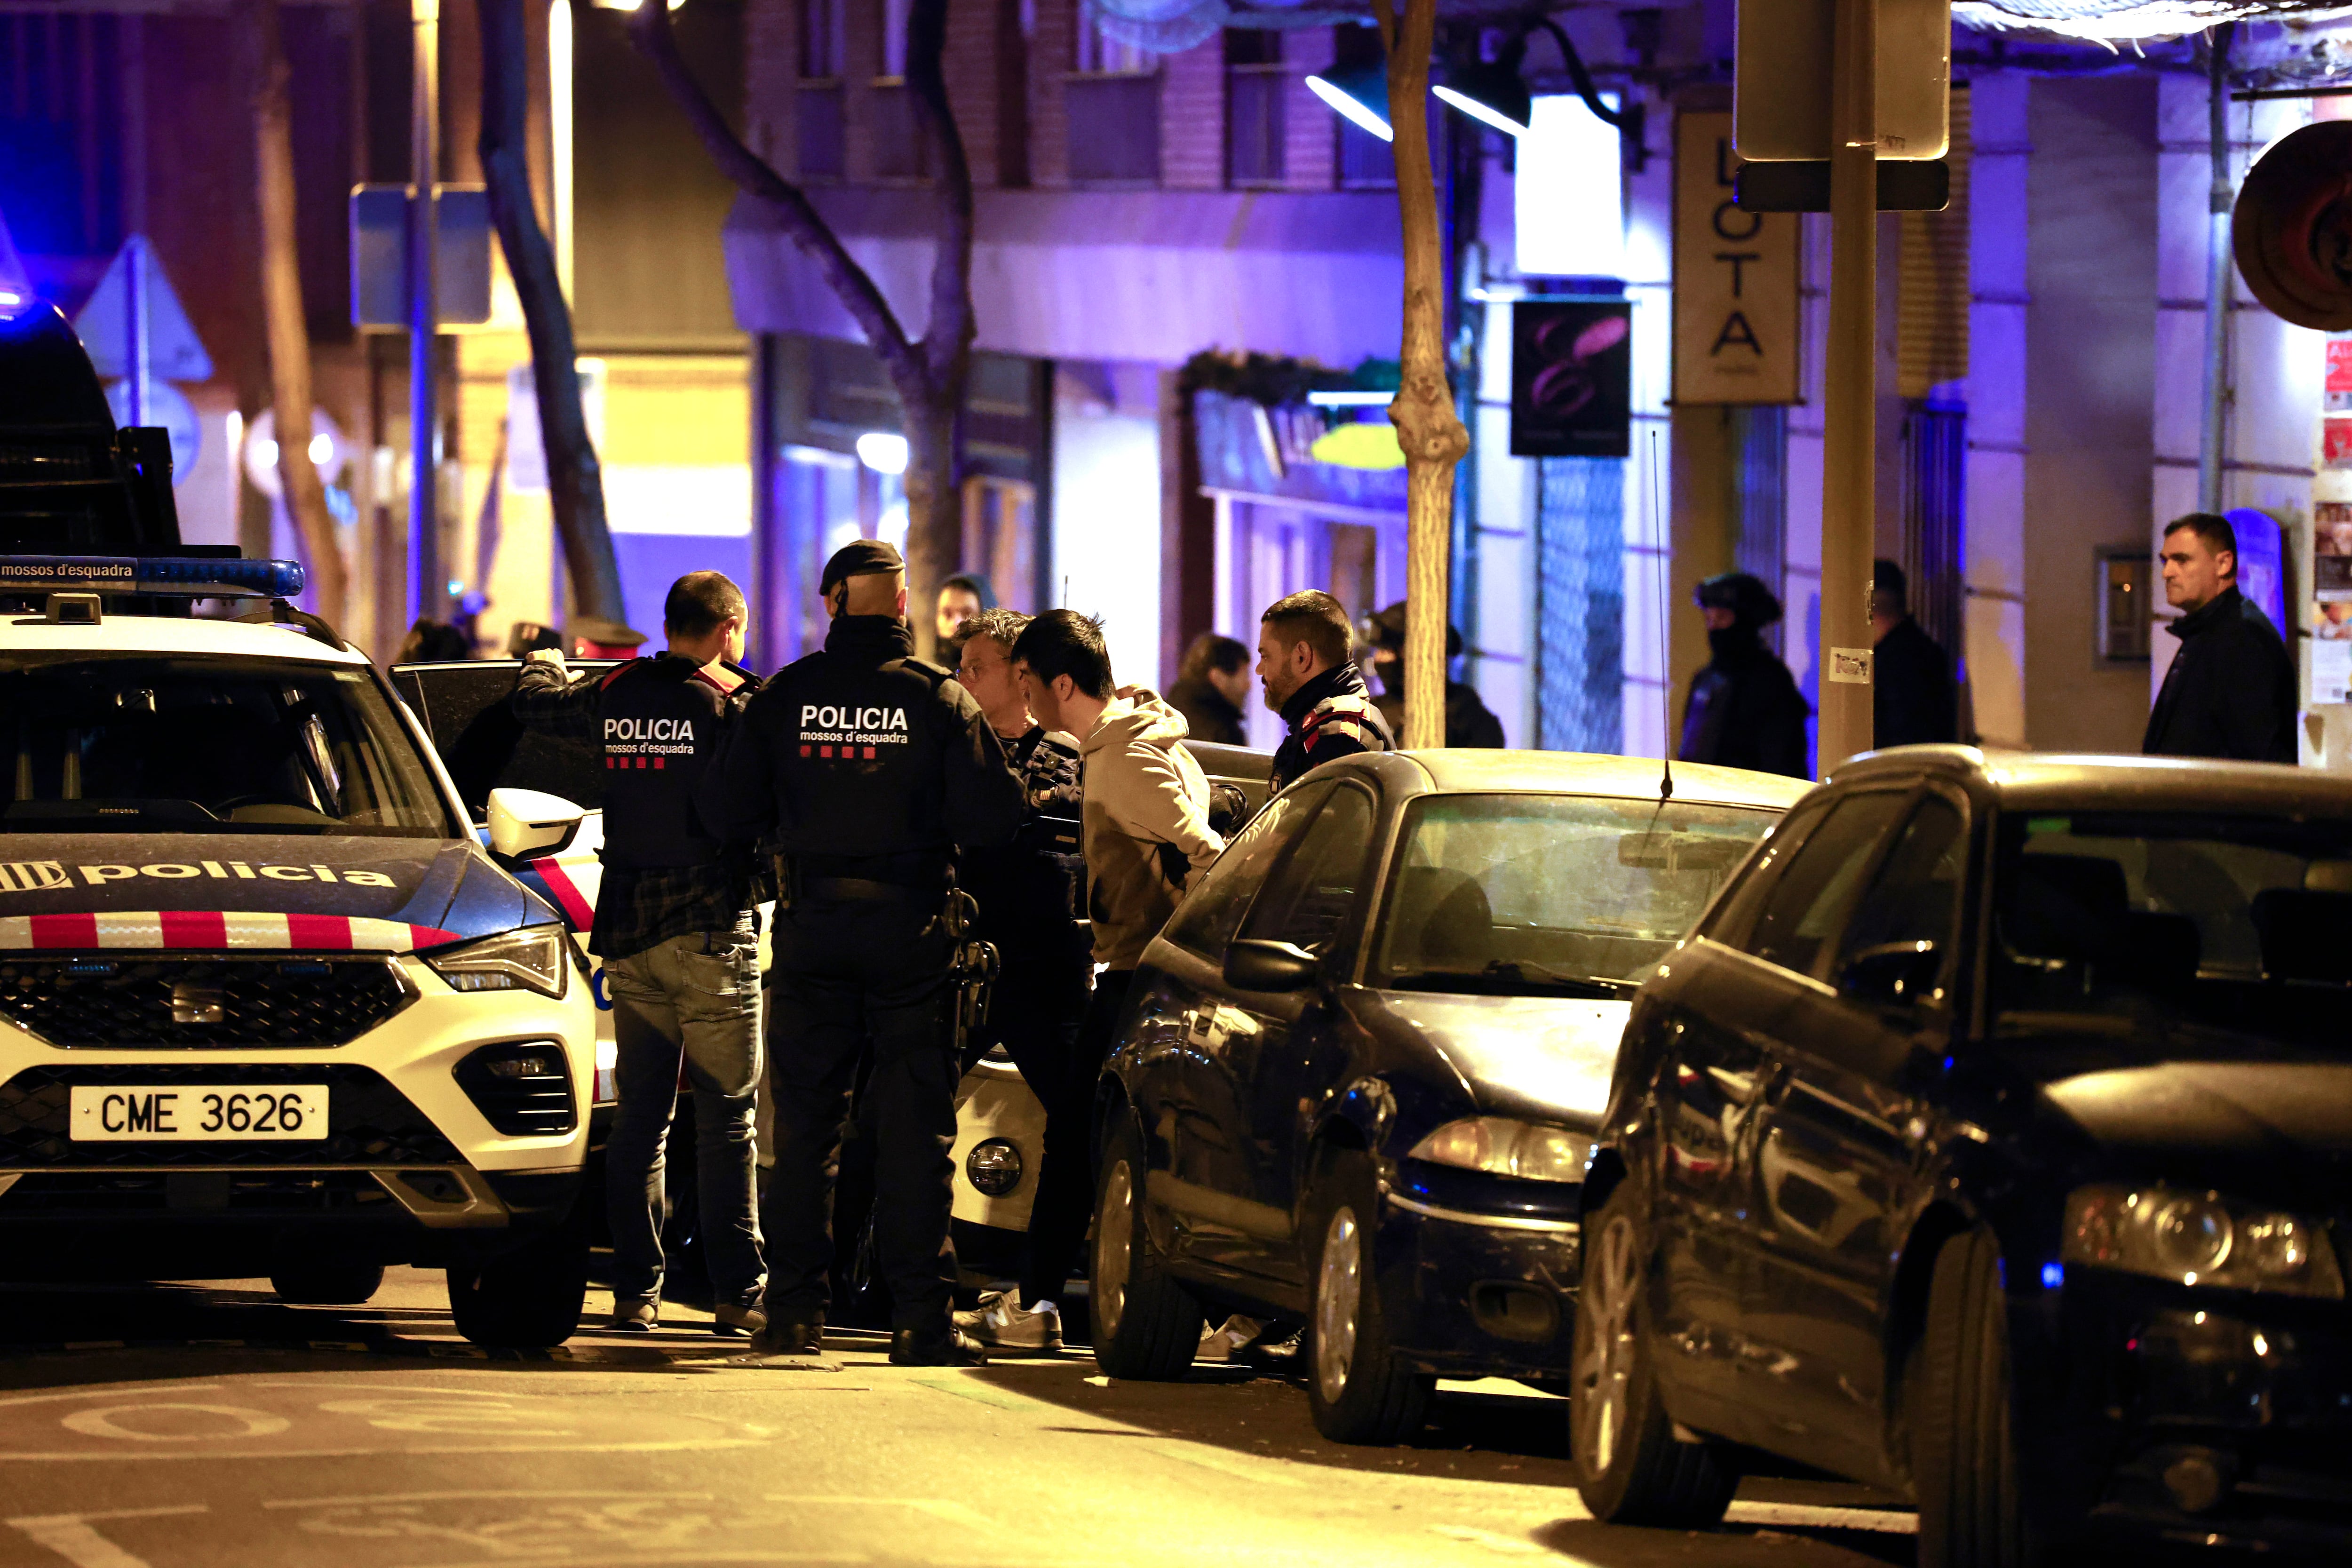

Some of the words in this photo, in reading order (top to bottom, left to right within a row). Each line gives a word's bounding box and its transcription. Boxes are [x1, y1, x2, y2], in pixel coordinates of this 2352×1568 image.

[1712, 140, 1762, 356] LOTA
[1, 565, 54, 576] mossos
[56, 564, 133, 578] d'esquadra
[604, 718, 694, 740] POLICIA
[801, 705, 908, 730] POLICIA
[605, 744, 637, 753] mossos
[640, 742, 694, 755] d'esquadra
[801, 732, 843, 741] mossos
[845, 731, 908, 744] d'esquadra
[79, 860, 397, 888] policia
[102, 1094, 178, 1132] CME
[201, 1094, 303, 1132] 3626
